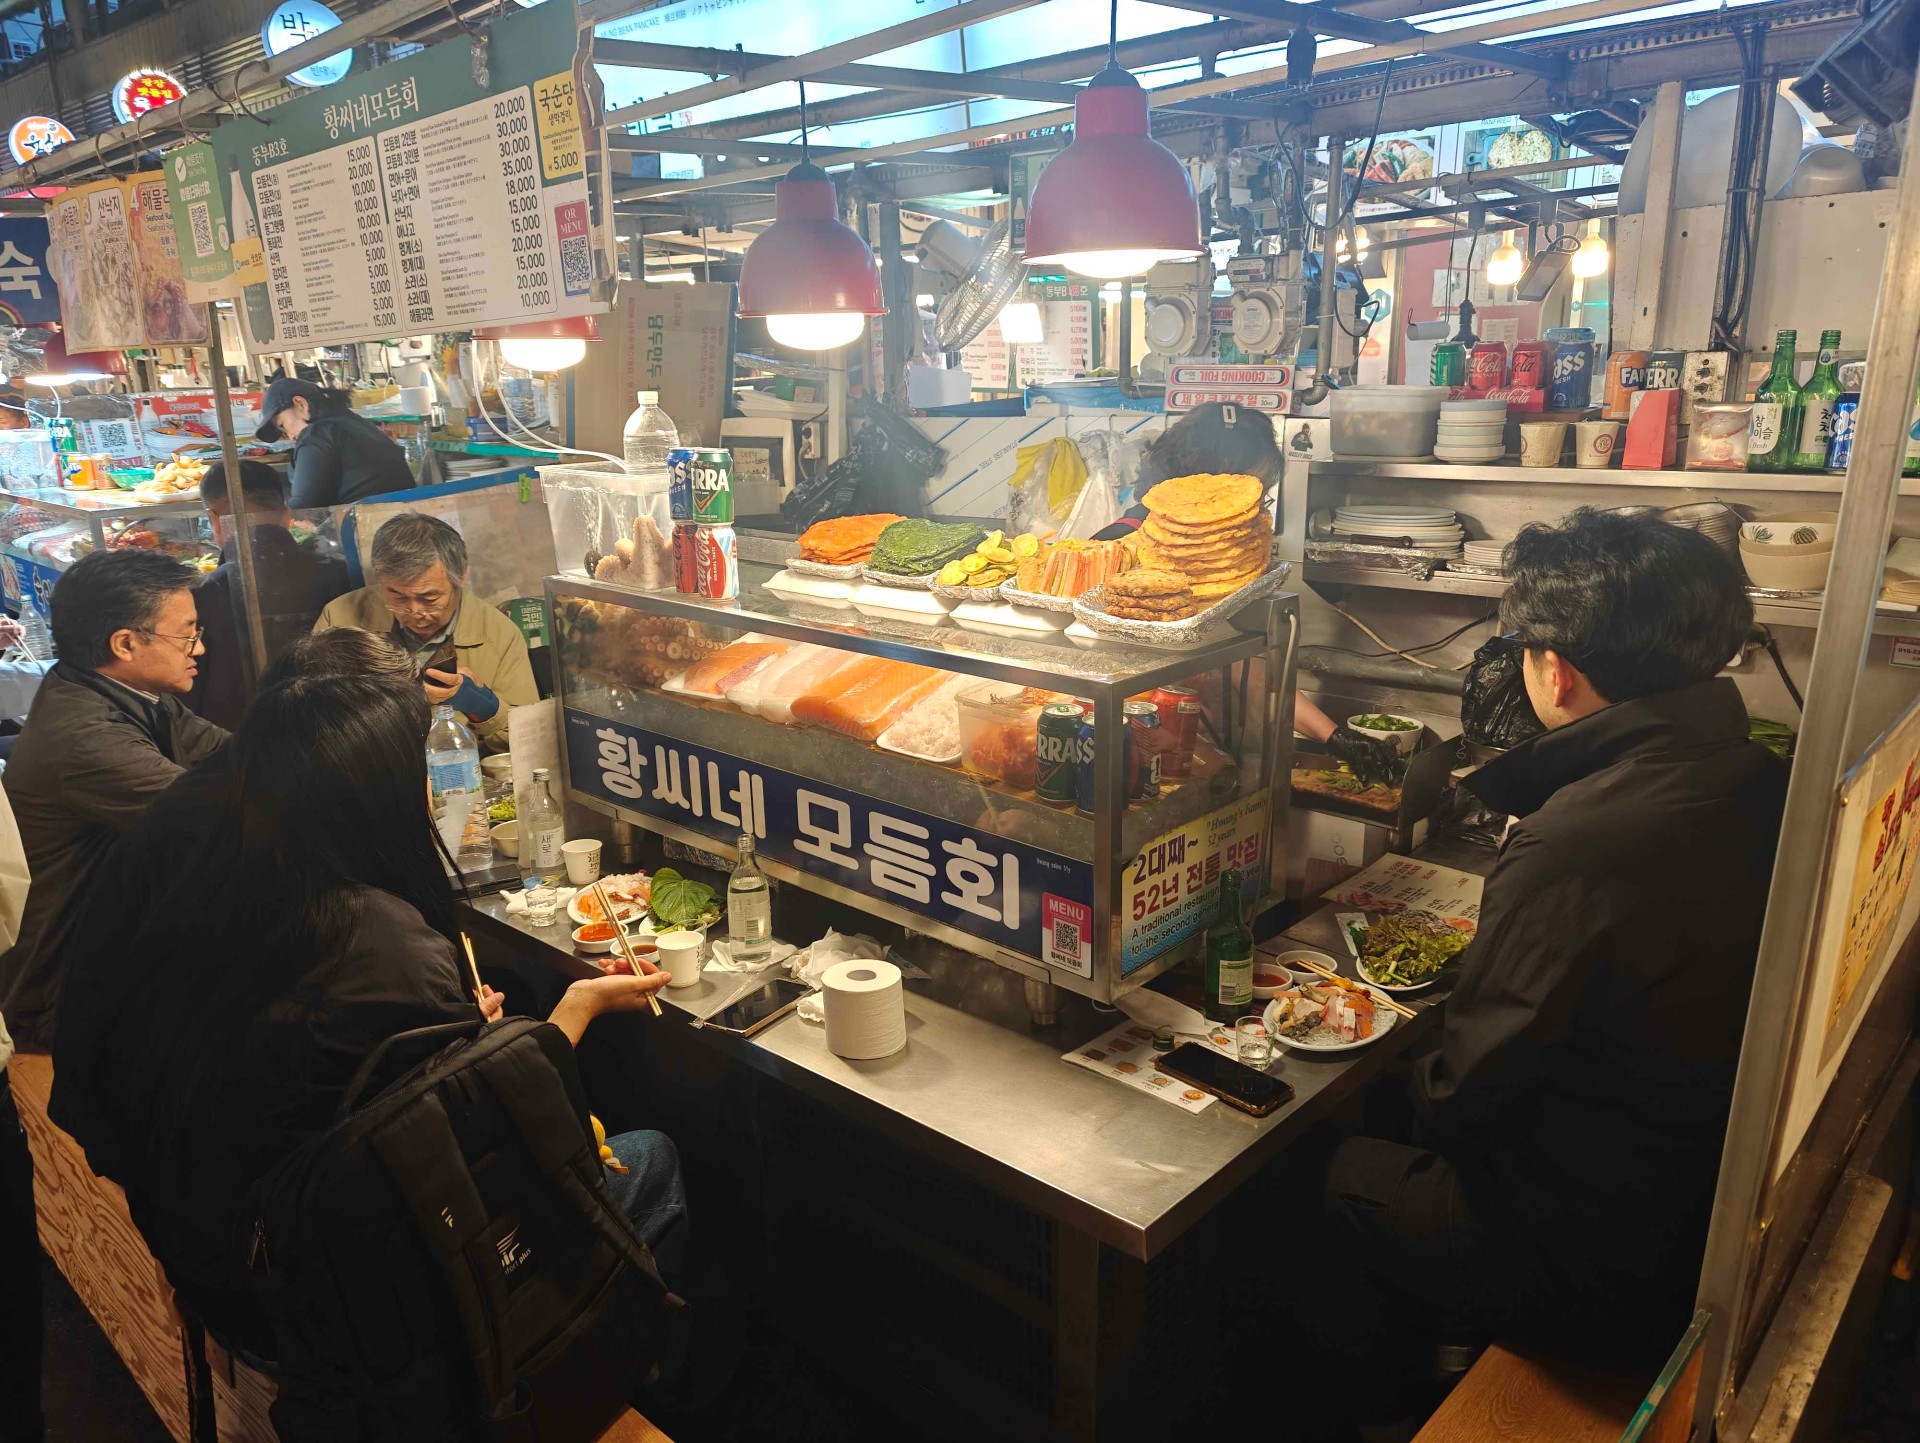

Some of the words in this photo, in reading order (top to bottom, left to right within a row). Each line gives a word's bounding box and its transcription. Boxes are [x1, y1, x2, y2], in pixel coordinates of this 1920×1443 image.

[617, 23, 633, 34] BEAN
[634, 17, 660, 30] PANCAKE
[324, 77, 418, 138] 황씨네모듬회
[540, 82, 574, 112] 국순당
[384, 132, 400, 152] 모듬회
[401, 129, 416, 147] 2인분
[494, 95, 525, 119] 20,000
[548, 110, 572, 127] 생막걸리
[252, 138, 289, 166] 동부B3호
[347, 144, 371, 163] 15,000
[386, 151, 402, 170] 모듬회
[404, 148, 420, 166] 3인분
[496, 116, 528, 138] 30,000
[348, 162, 373, 180] 20,000
[388, 166, 418, 187] 연어+문어
[499, 135, 531, 158] 30,000
[391, 184, 421, 205] 낙지+연어
[502, 155, 533, 177] 35,000
[97, 193, 122, 219] 산낙지
[130, 184, 140, 212] 4
[262, 203, 282, 220] 새우튀김
[352, 178, 376, 198] 10,000
[394, 205, 413, 222] 산낙지
[506, 174, 536, 196] 18,000
[564, 207, 577, 220] QR
[264, 218, 286, 236] 동그랑땡
[354, 196, 378, 214] 10,000
[357, 213, 381, 231] 10,000
[396, 222, 416, 238] 아나고
[509, 194, 538, 214] 15,000
[560, 219, 584, 236] MENU
[360, 230, 384, 247] 10,000
[399, 238, 423, 257] 멍게(소)
[511, 214, 541, 234] 15,000
[272, 266, 288, 281] 김치전
[366, 246, 386, 262] 5,000
[402, 255, 426, 274] 멍게(대)
[512, 233, 543, 253] 20,000
[274, 281, 291, 296] 부추전
[368, 262, 388, 280] 5,000
[404, 272, 428, 290] 소라(소)
[516, 252, 546, 271] 15,000
[277, 296, 294, 311] 빈대떡
[370, 279, 391, 296] 5,000
[373, 296, 394, 312] 5,000
[407, 289, 431, 306] 소라(대)
[517, 271, 548, 290] 20,000
[373, 312, 397, 328] 15,000
[409, 306, 434, 323] 해물라면
[520, 290, 550, 308] 10,000
[647, 314, 665, 379] 담두만두
[1200, 370, 1221, 383] FOIL
[1221, 370, 1266, 383] COOKING
[1554, 350, 1586, 378] ass
[1753, 427, 1774, 441] 이슬
[1755, 415, 1766, 428] 참
[1834, 433, 1854, 442] FRES
[596, 727, 767, 839] 황씨네
[793, 788, 1020, 930] 모듬회
[1132, 872, 1179, 922] 52년
[1186, 852, 1220, 895] 전통
[1226, 832, 1259, 870] 맛집
[1049, 898, 1085, 922] MENU
[1131, 928, 1139, 941] A
[1141, 903, 1182, 936] traditional
[1184, 886, 1220, 910] restauran
[1130, 942, 1144, 957] for
[1145, 933, 1160, 948] the
[1161, 917, 1190, 940] second
[1192, 901, 1219, 924] genera
[518, 1247, 532, 1265] plus
